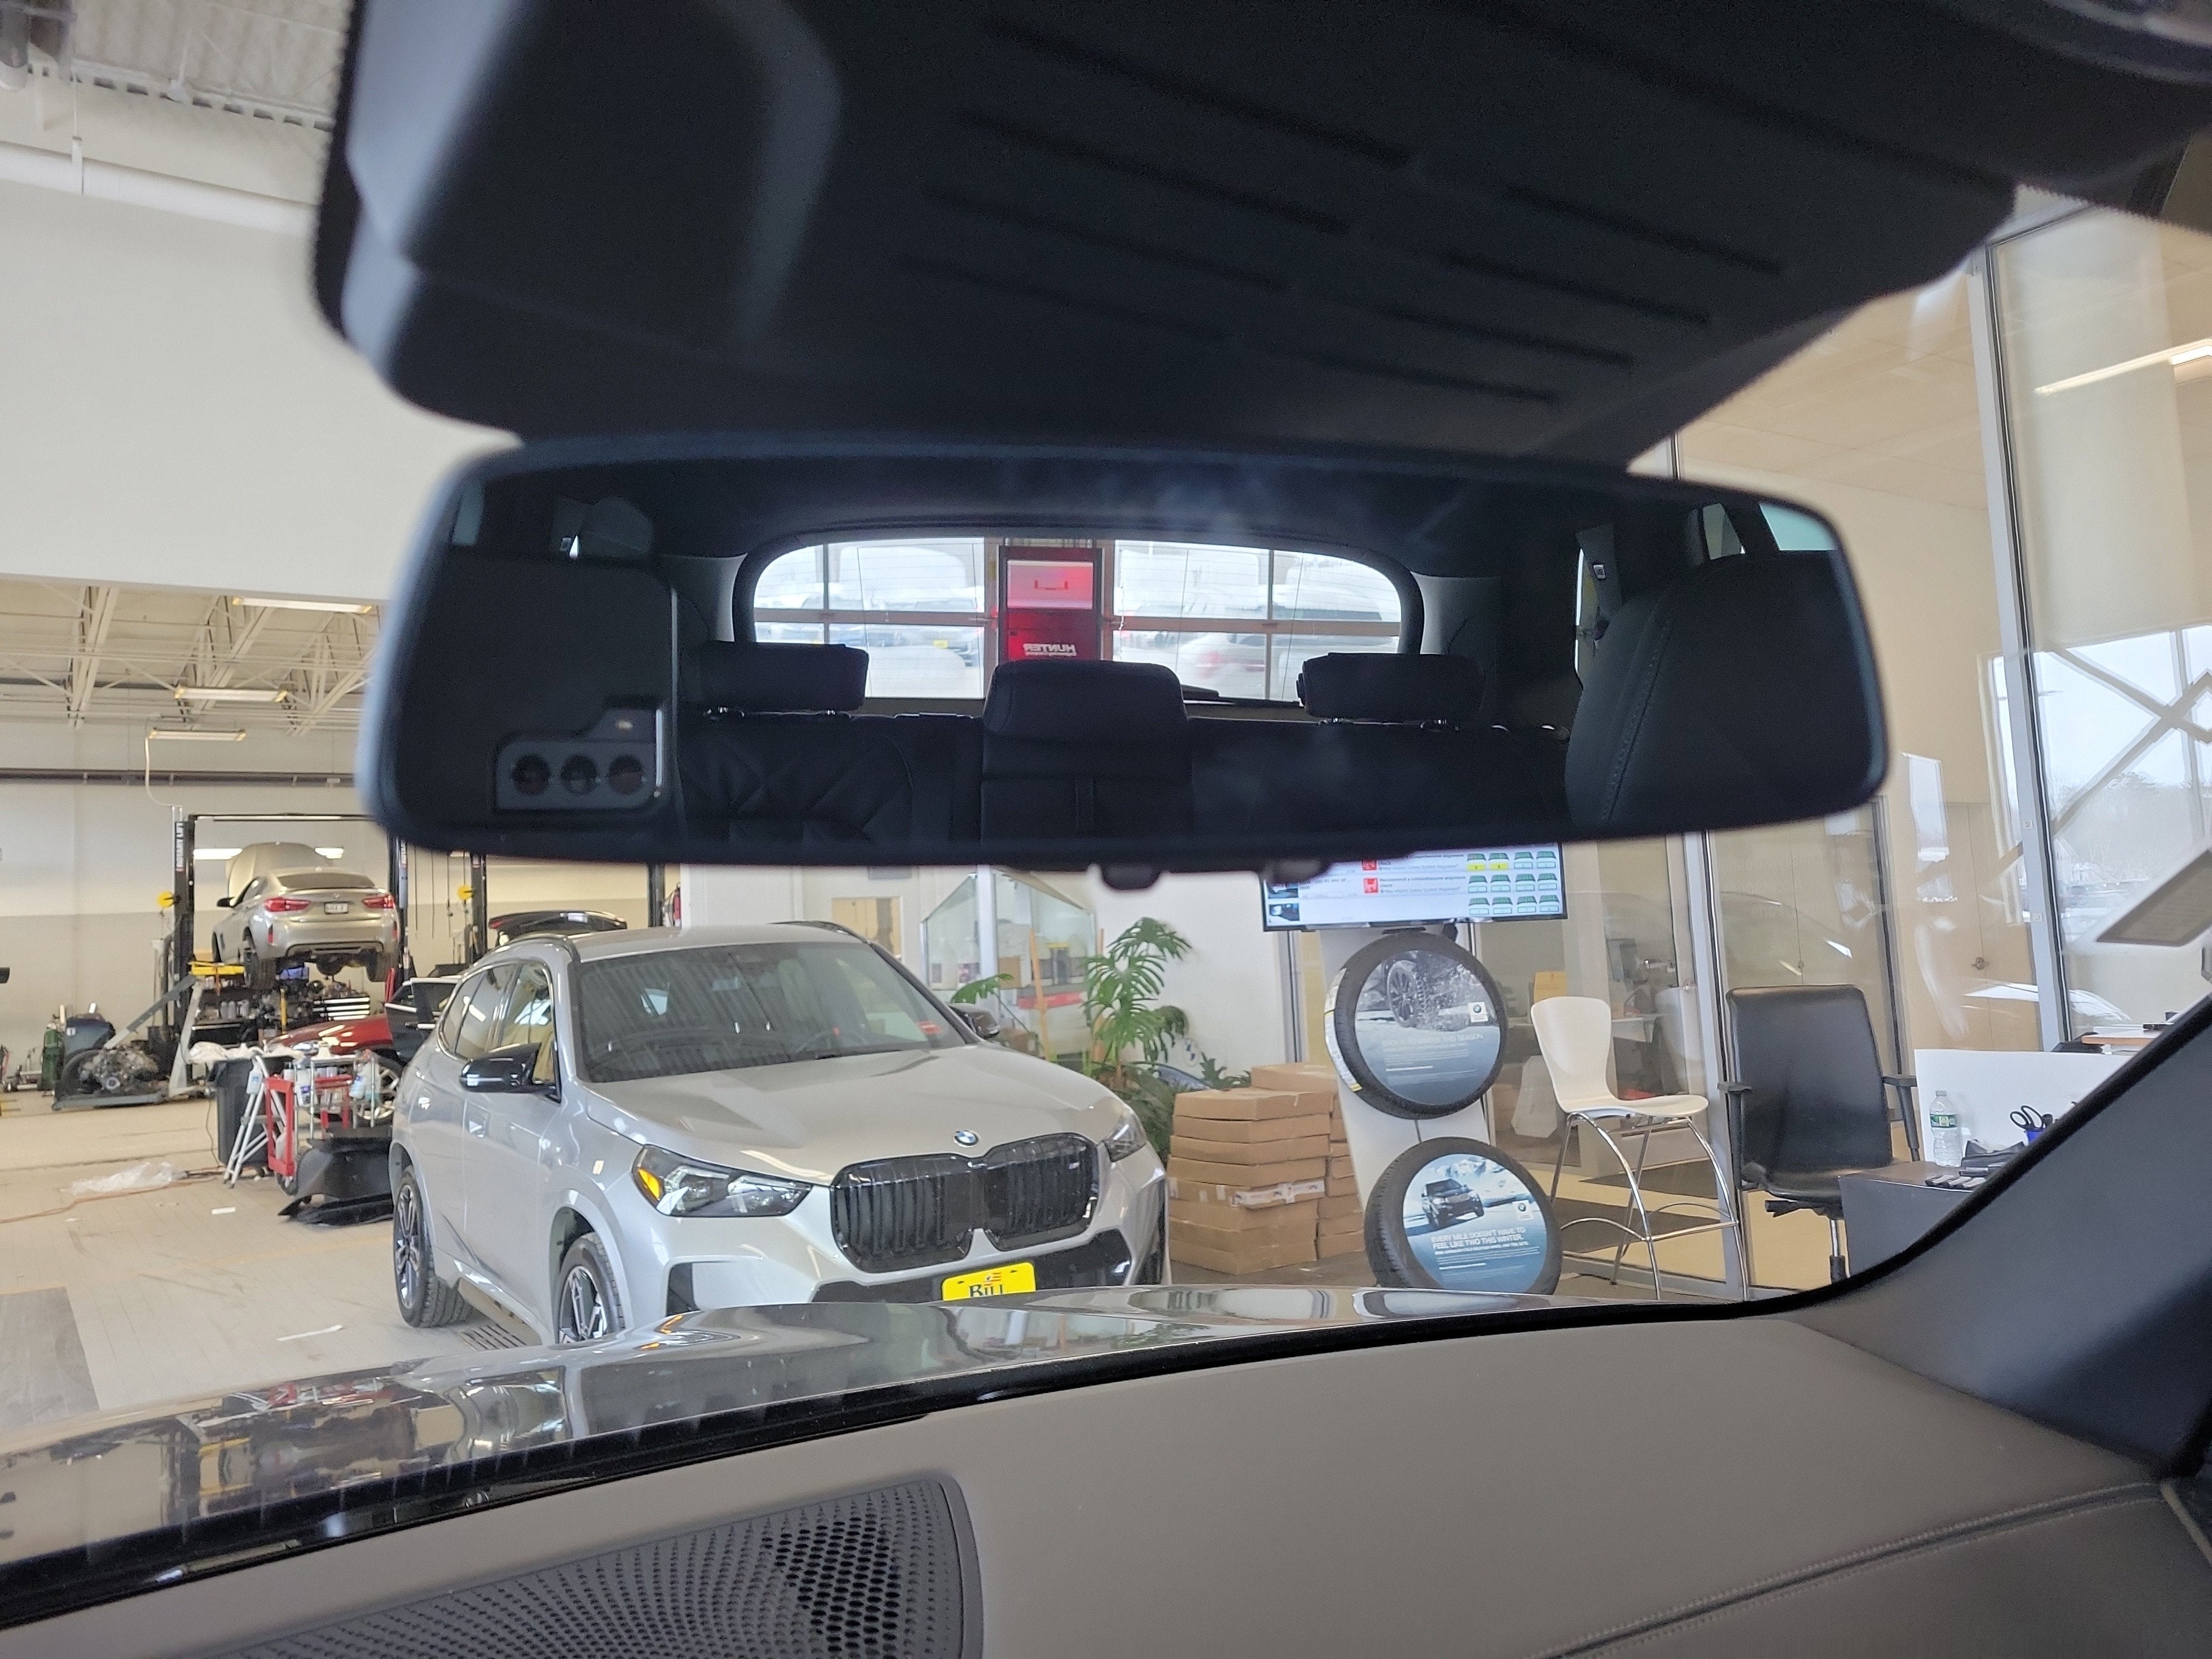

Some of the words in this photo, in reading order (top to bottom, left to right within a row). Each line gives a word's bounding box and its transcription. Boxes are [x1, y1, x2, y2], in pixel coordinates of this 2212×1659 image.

[1497, 1228, 1516, 1237] HAVE
[1465, 1238, 1481, 1246] TWO
[1481, 1237, 1497, 1245] THIS
